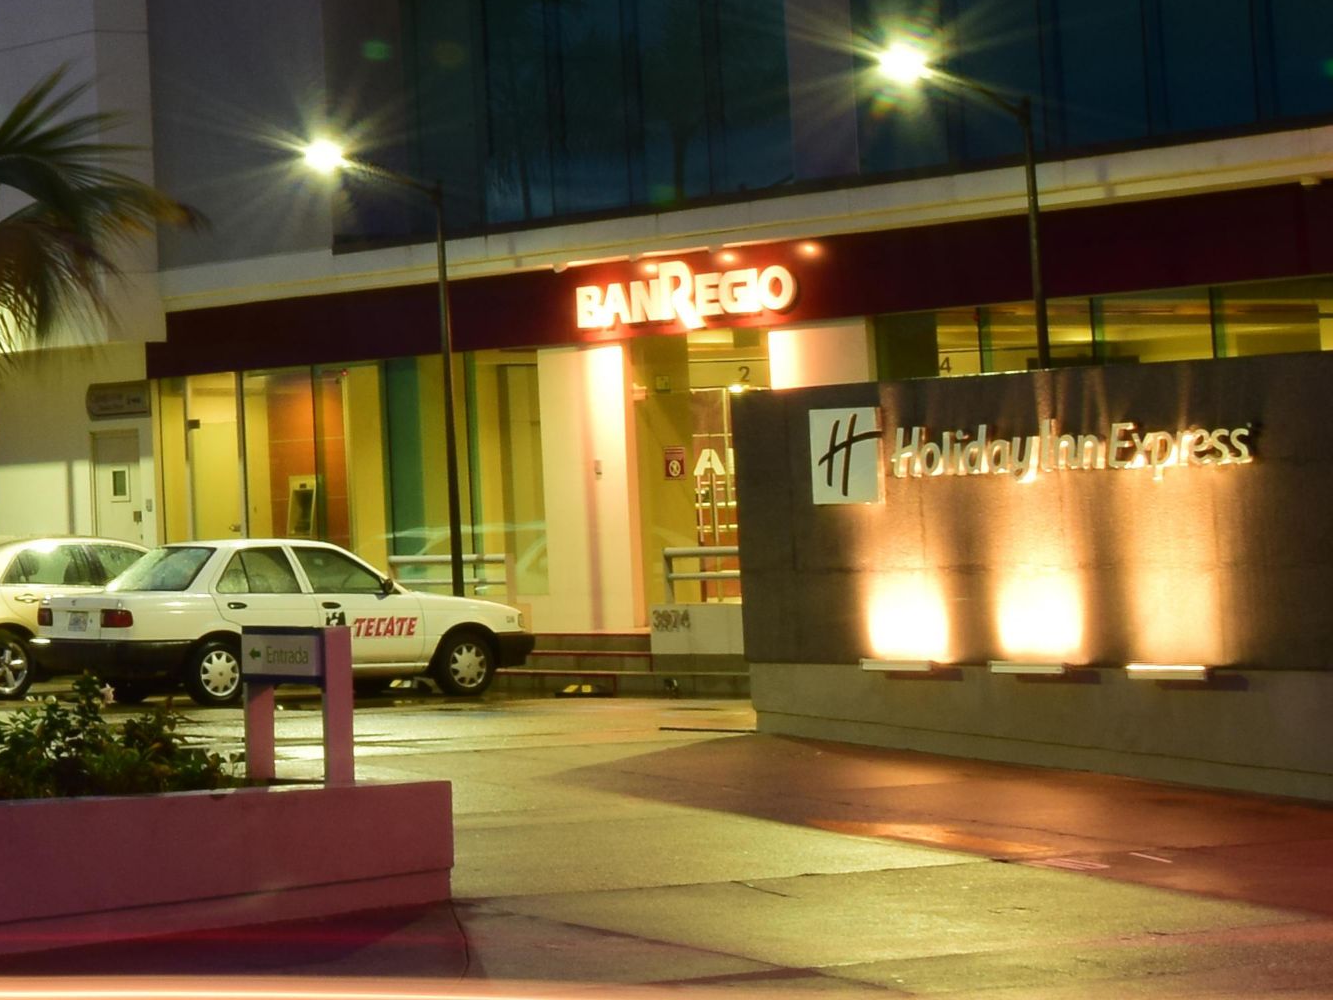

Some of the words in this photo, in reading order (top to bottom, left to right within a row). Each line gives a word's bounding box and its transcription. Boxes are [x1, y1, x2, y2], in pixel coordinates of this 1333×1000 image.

[738, 365, 750, 383] 2
[891, 424, 1038, 484] Holiday
[1039, 419, 1106, 473] Inn
[1109, 422, 1253, 481] Express
[353, 616, 418, 638] TECATE
[265, 646, 309, 665] Entrada
